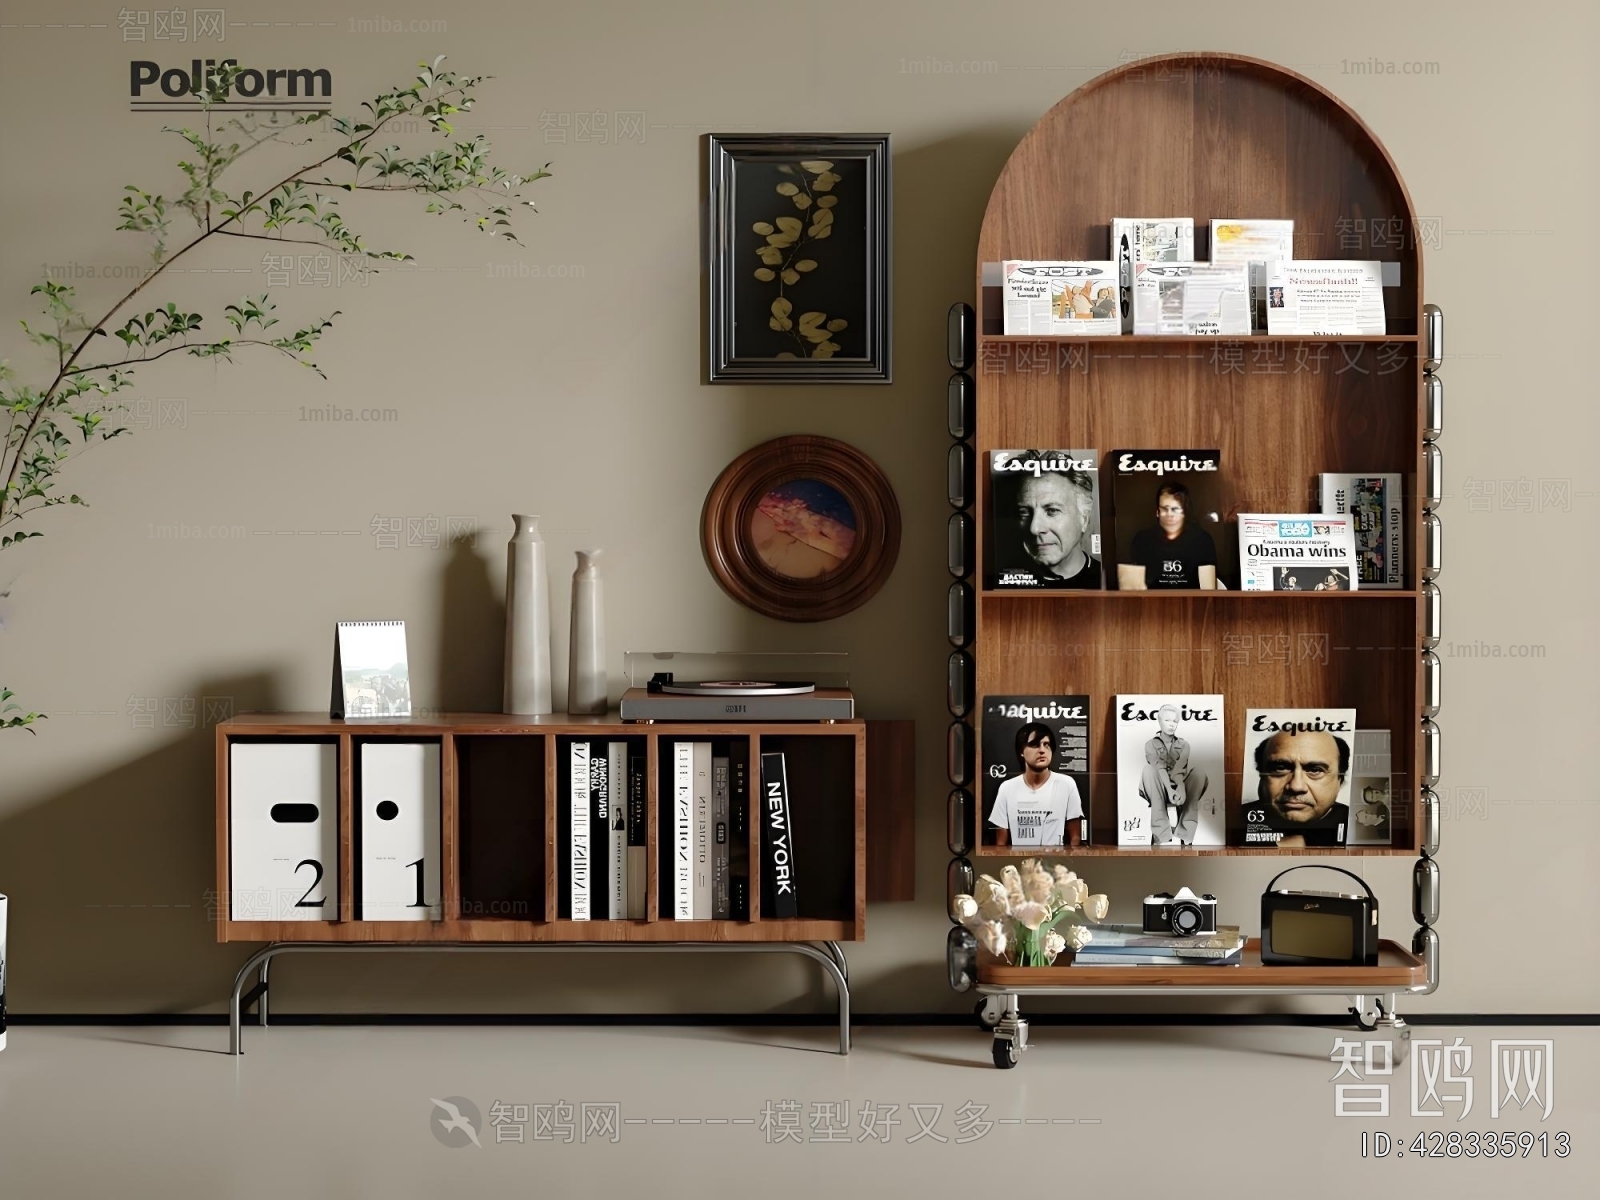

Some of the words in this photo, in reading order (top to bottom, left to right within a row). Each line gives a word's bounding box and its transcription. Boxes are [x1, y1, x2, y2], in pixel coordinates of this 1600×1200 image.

[130, 59, 332, 97] Poliform
[993, 452, 1099, 477] Esquire
[1118, 453, 1218, 476] Esquire
[1247, 543, 1304, 558] Obama
[1309, 544, 1347, 558] wins
[1252, 715, 1351, 736] Esquire
[989, 764, 1007, 778] 62
[767, 781, 785, 830] NEW
[1247, 809, 1265, 823] 63
[773, 834, 792, 895] YORK
[294, 858, 328, 908] 2
[405, 857, 434, 908] 1
